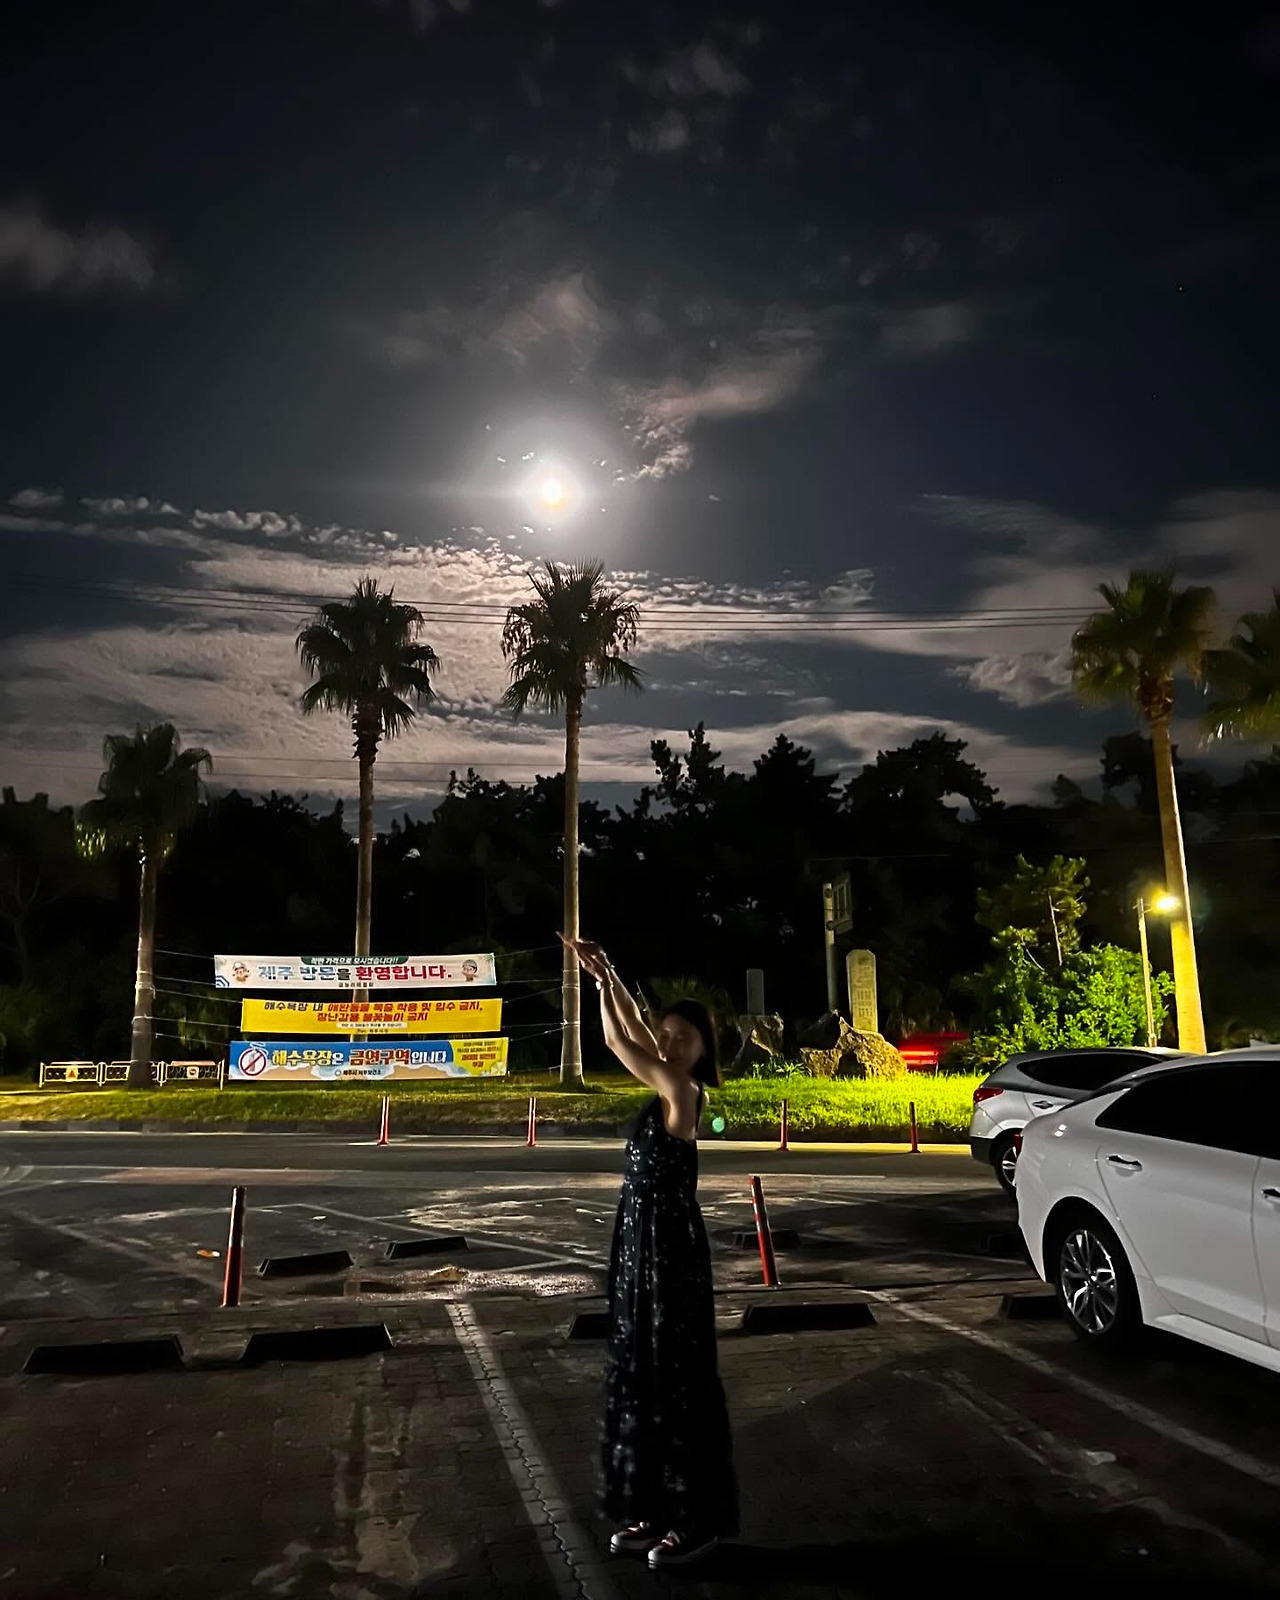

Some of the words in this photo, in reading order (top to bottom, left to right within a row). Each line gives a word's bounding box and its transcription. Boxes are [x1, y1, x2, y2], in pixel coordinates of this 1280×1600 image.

[258, 966, 294, 981] 제주
[299, 965, 351, 981] 방문을
[355, 964, 452, 981] 환영합니다.
[264, 1001, 308, 1012] 해수욕장
[312, 1002, 324, 1012] 내
[328, 1003, 370, 1012] 애완동물
[397, 1003, 418, 1012] 착용
[422, 1002, 432, 1012] 및
[435, 1002, 456, 1011] 입수
[317, 1012, 359, 1022] 장난감용
[363, 1012, 404, 1022] 불꽃놀이
[407, 1012, 428, 1021] 금지
[271, 1049, 344, 1066] 해수욕장은
[349, 1048, 447, 1066] 금연구역입니다
